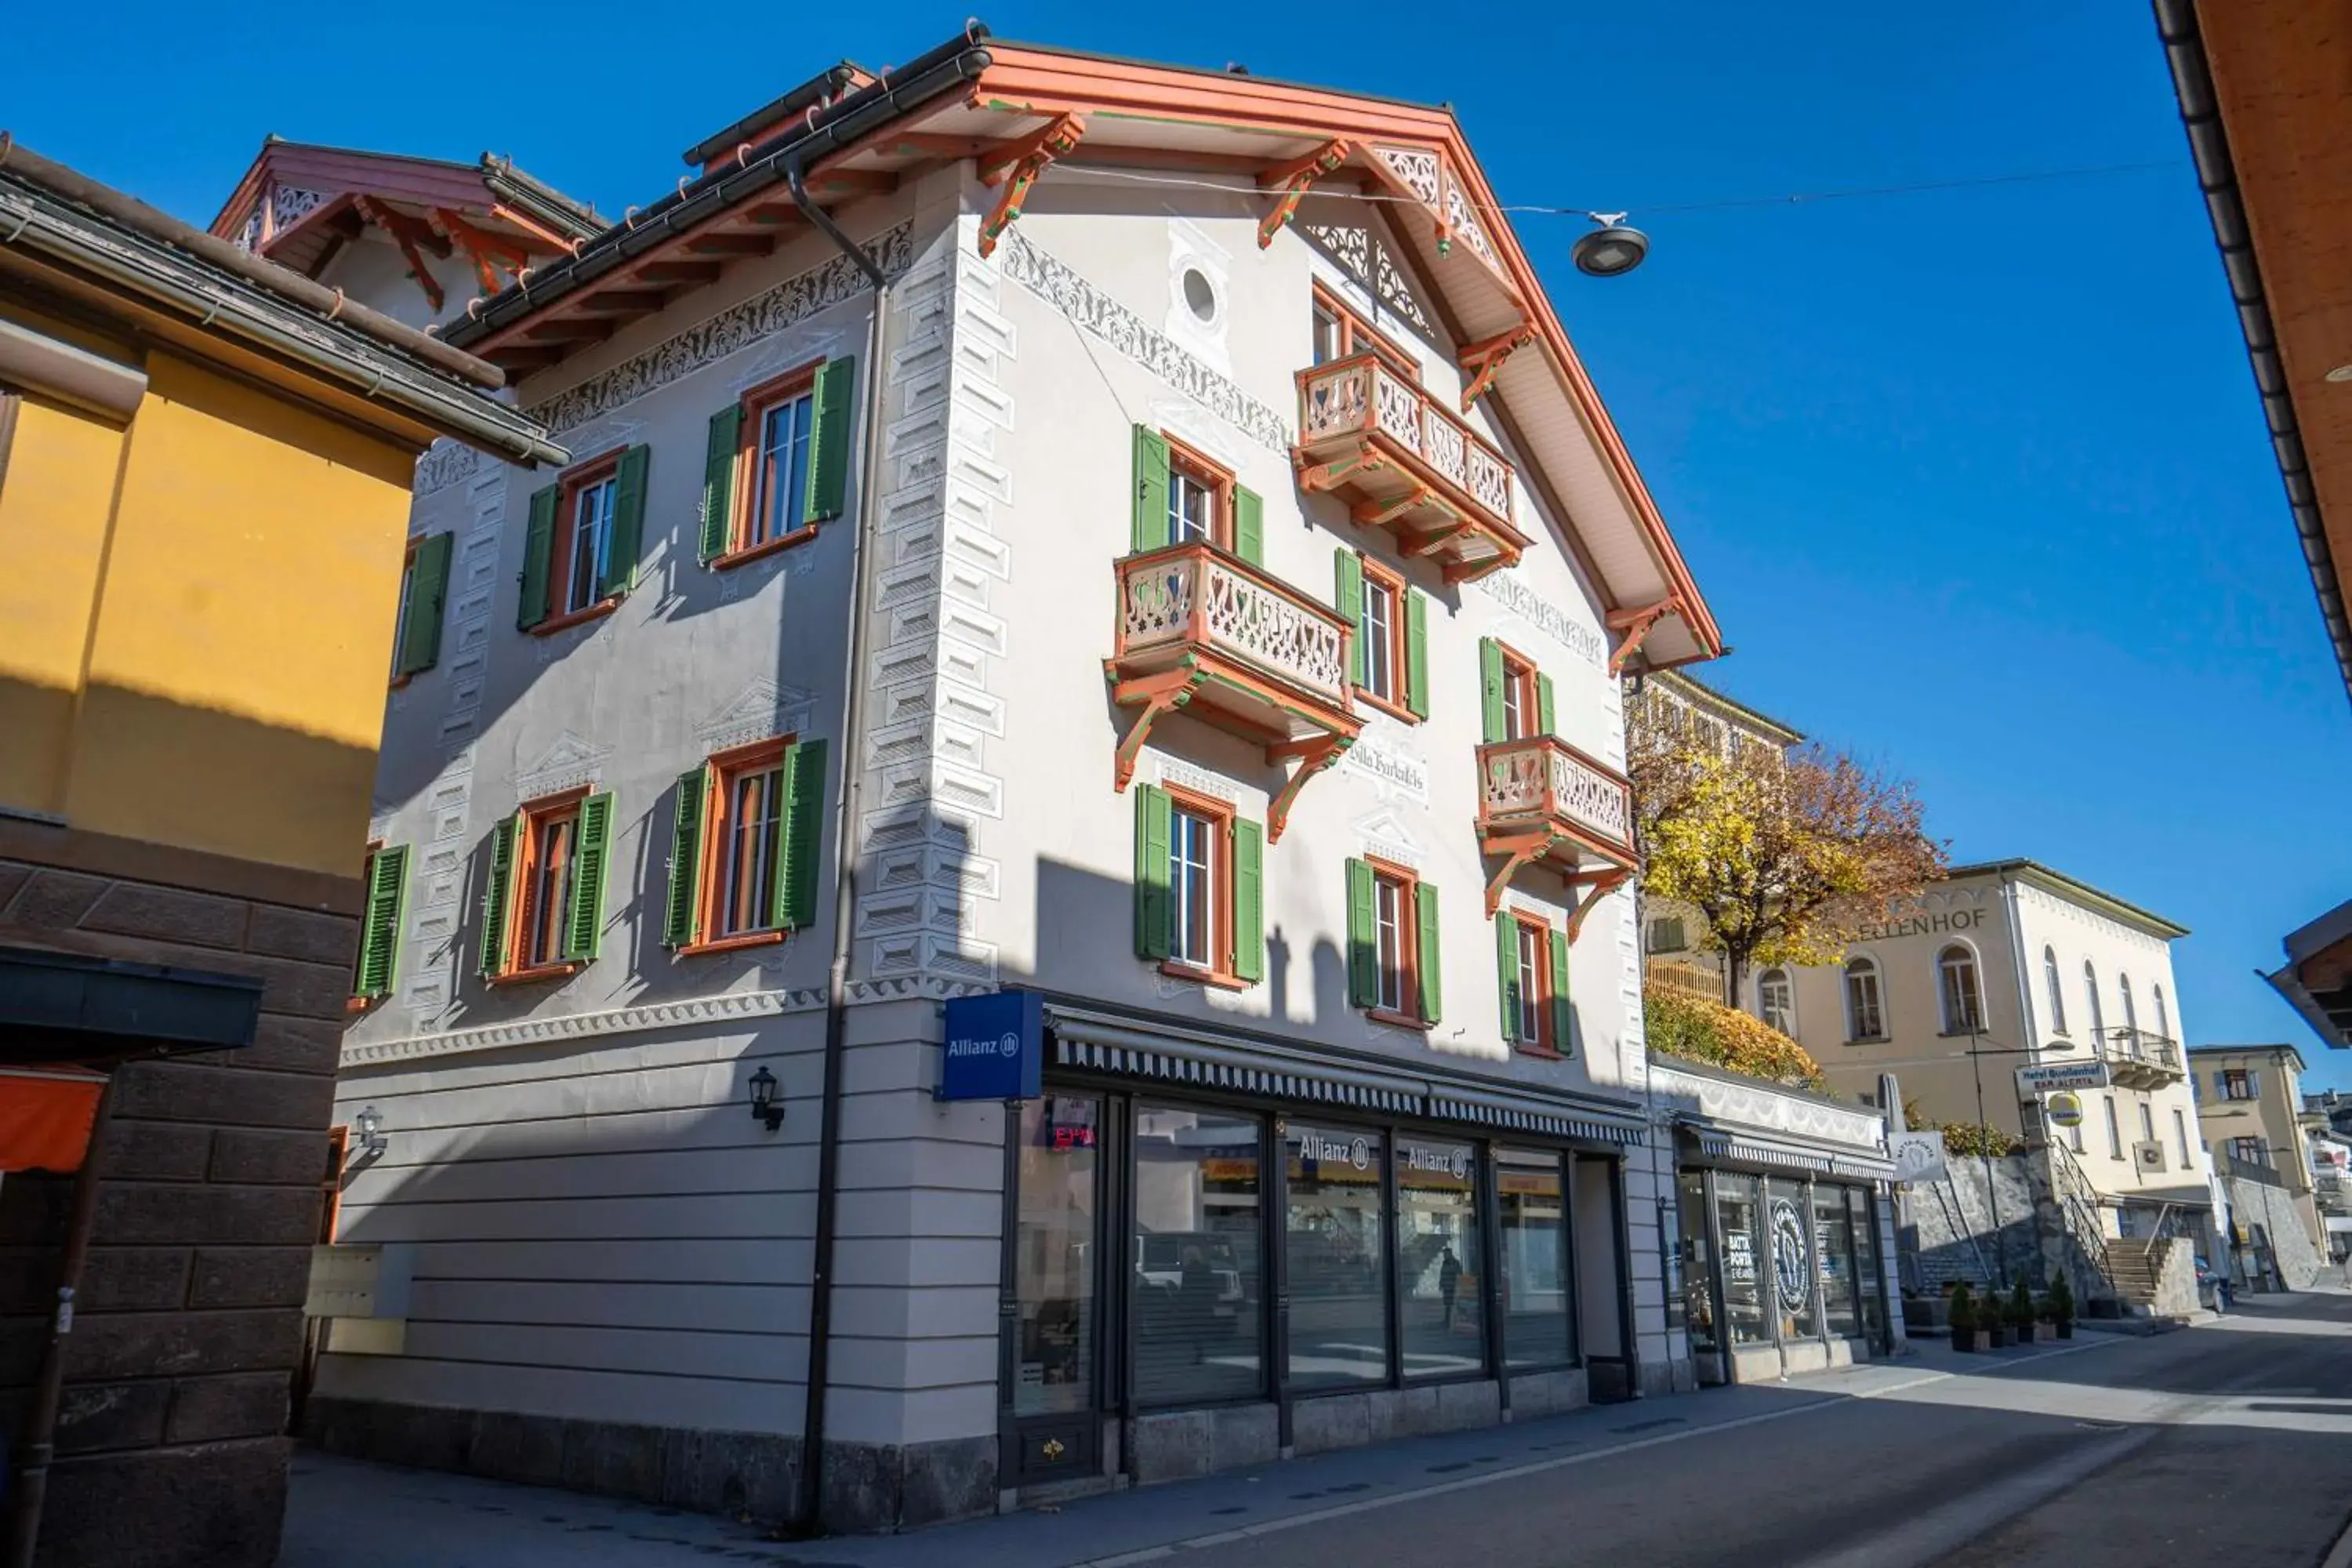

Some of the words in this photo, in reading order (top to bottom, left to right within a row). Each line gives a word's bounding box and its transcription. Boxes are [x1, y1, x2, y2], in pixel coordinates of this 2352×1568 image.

[1857, 907, 1988, 942] ELLENHOF
[948, 1039, 997, 1058] Allianz
[2023, 1069, 2047, 1080] Hotel
[1299, 1135, 1349, 1163] Allianz
[1409, 1147, 1450, 1172] Allianz
